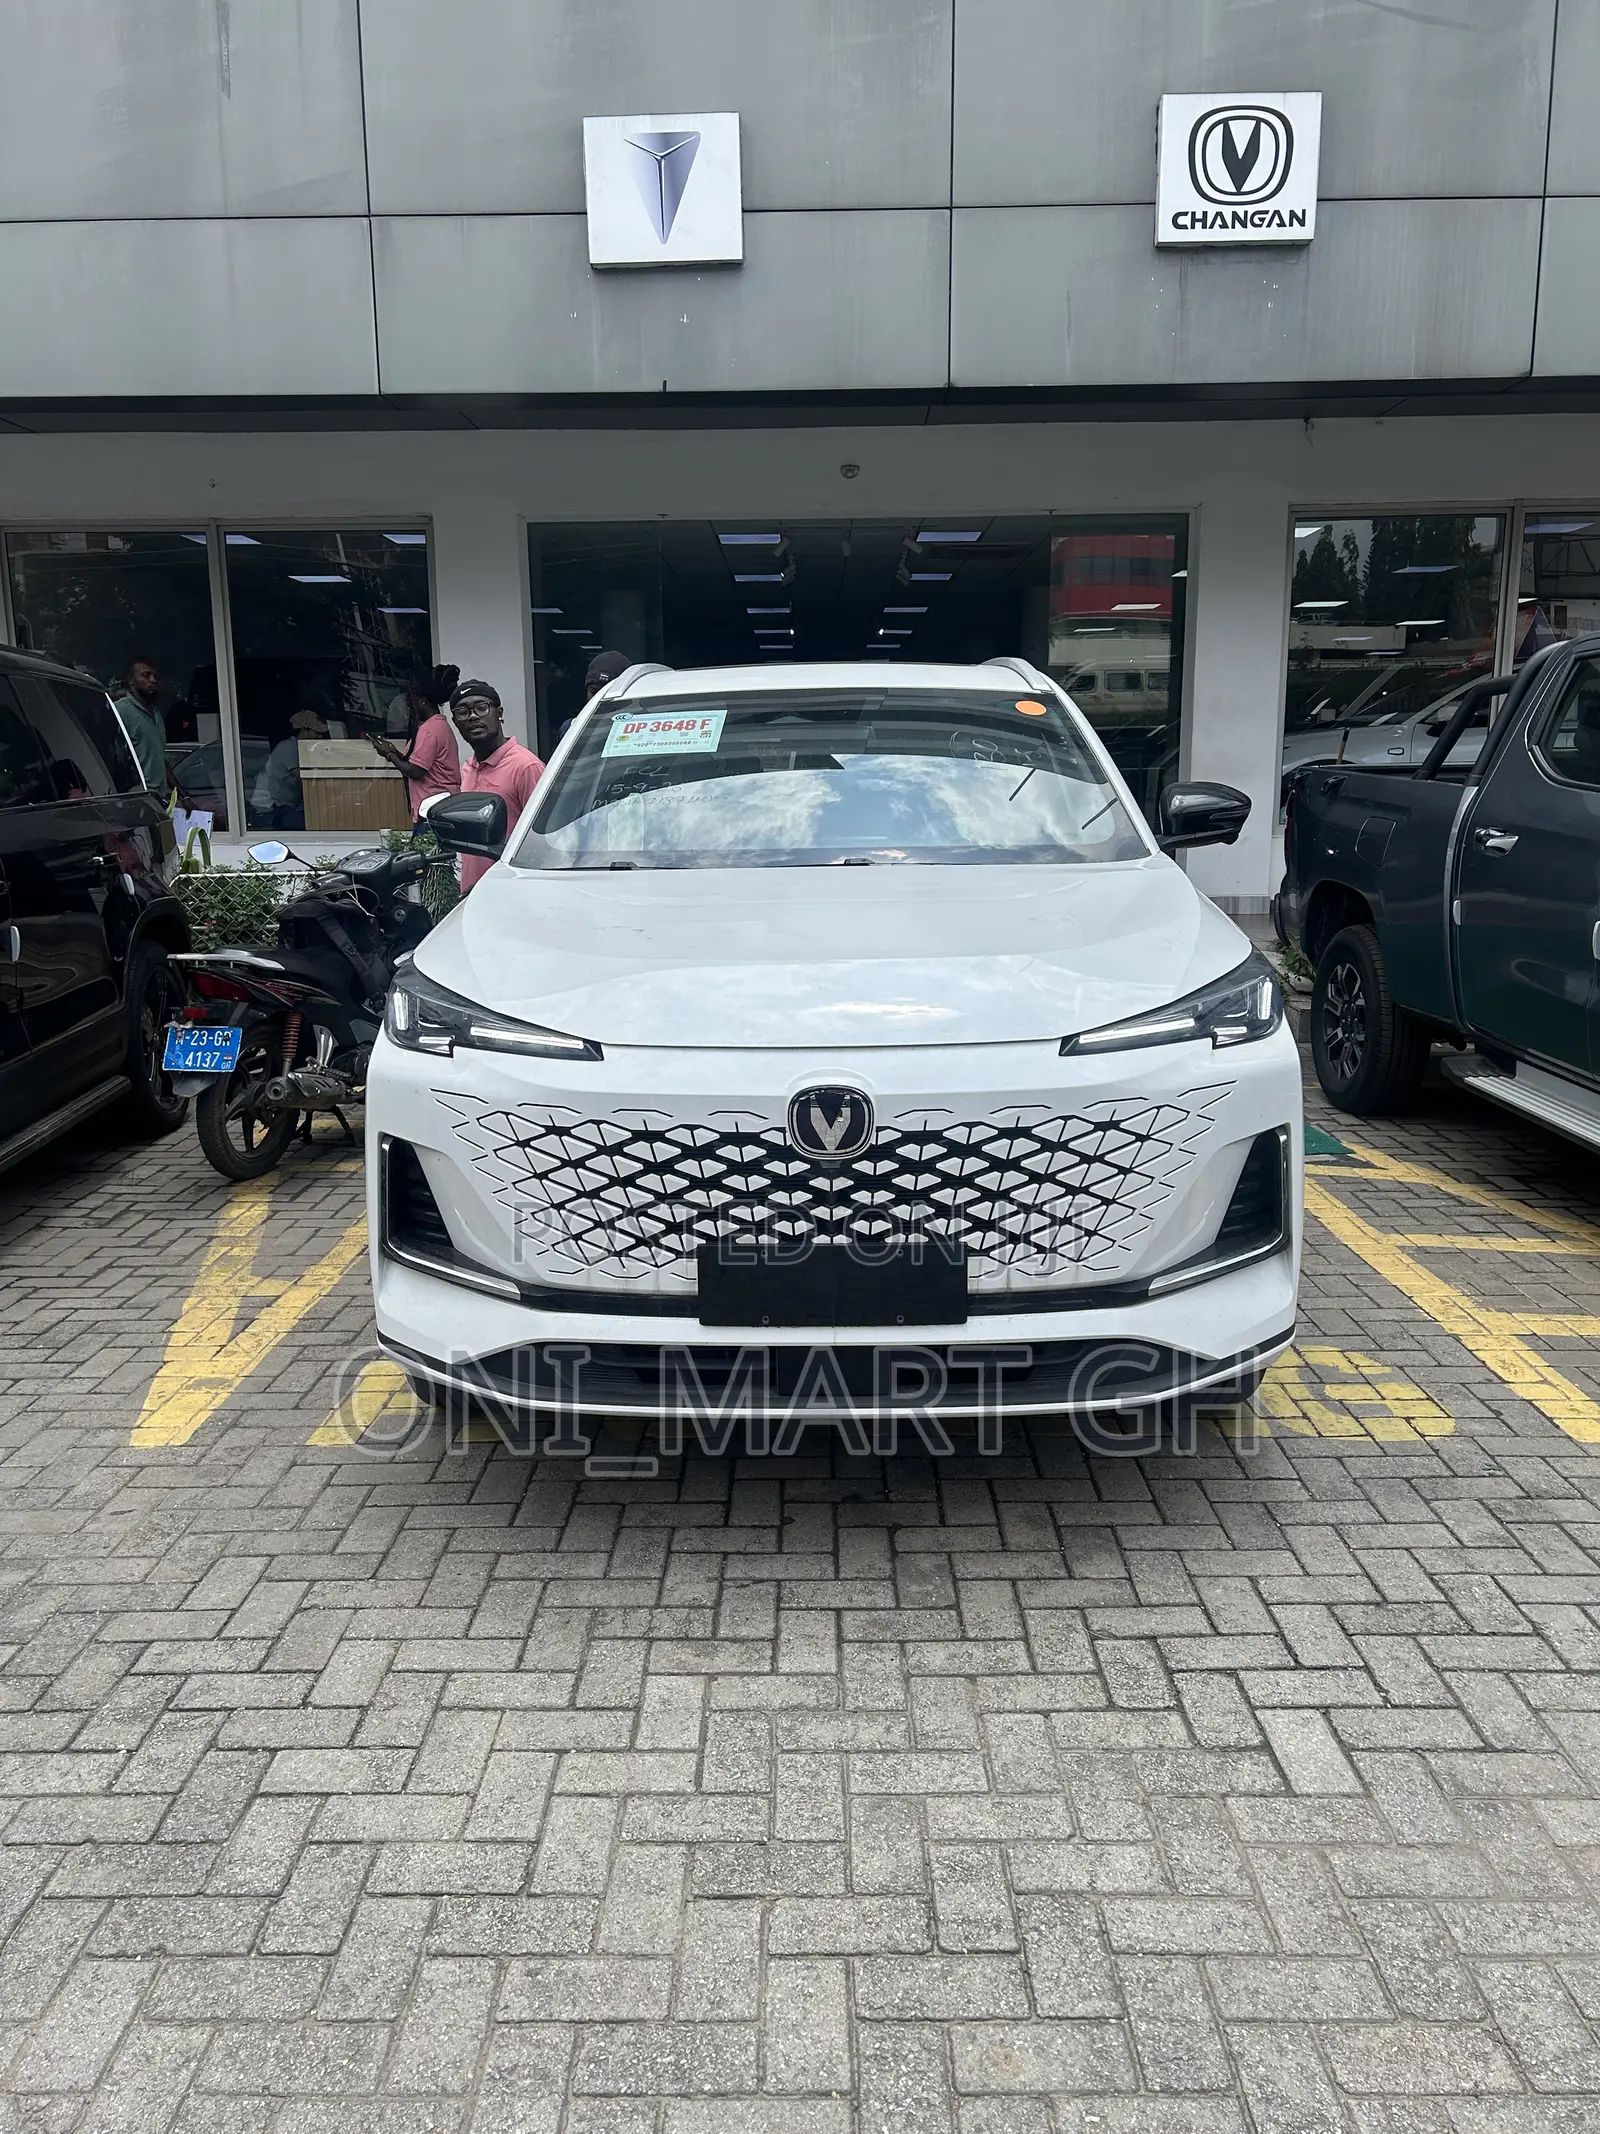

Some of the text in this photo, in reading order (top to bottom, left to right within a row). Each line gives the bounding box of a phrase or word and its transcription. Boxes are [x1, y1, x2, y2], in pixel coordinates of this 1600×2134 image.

[1171, 208, 1306, 230] CHANGAN
[623, 718, 713, 734] DP 3648 F
